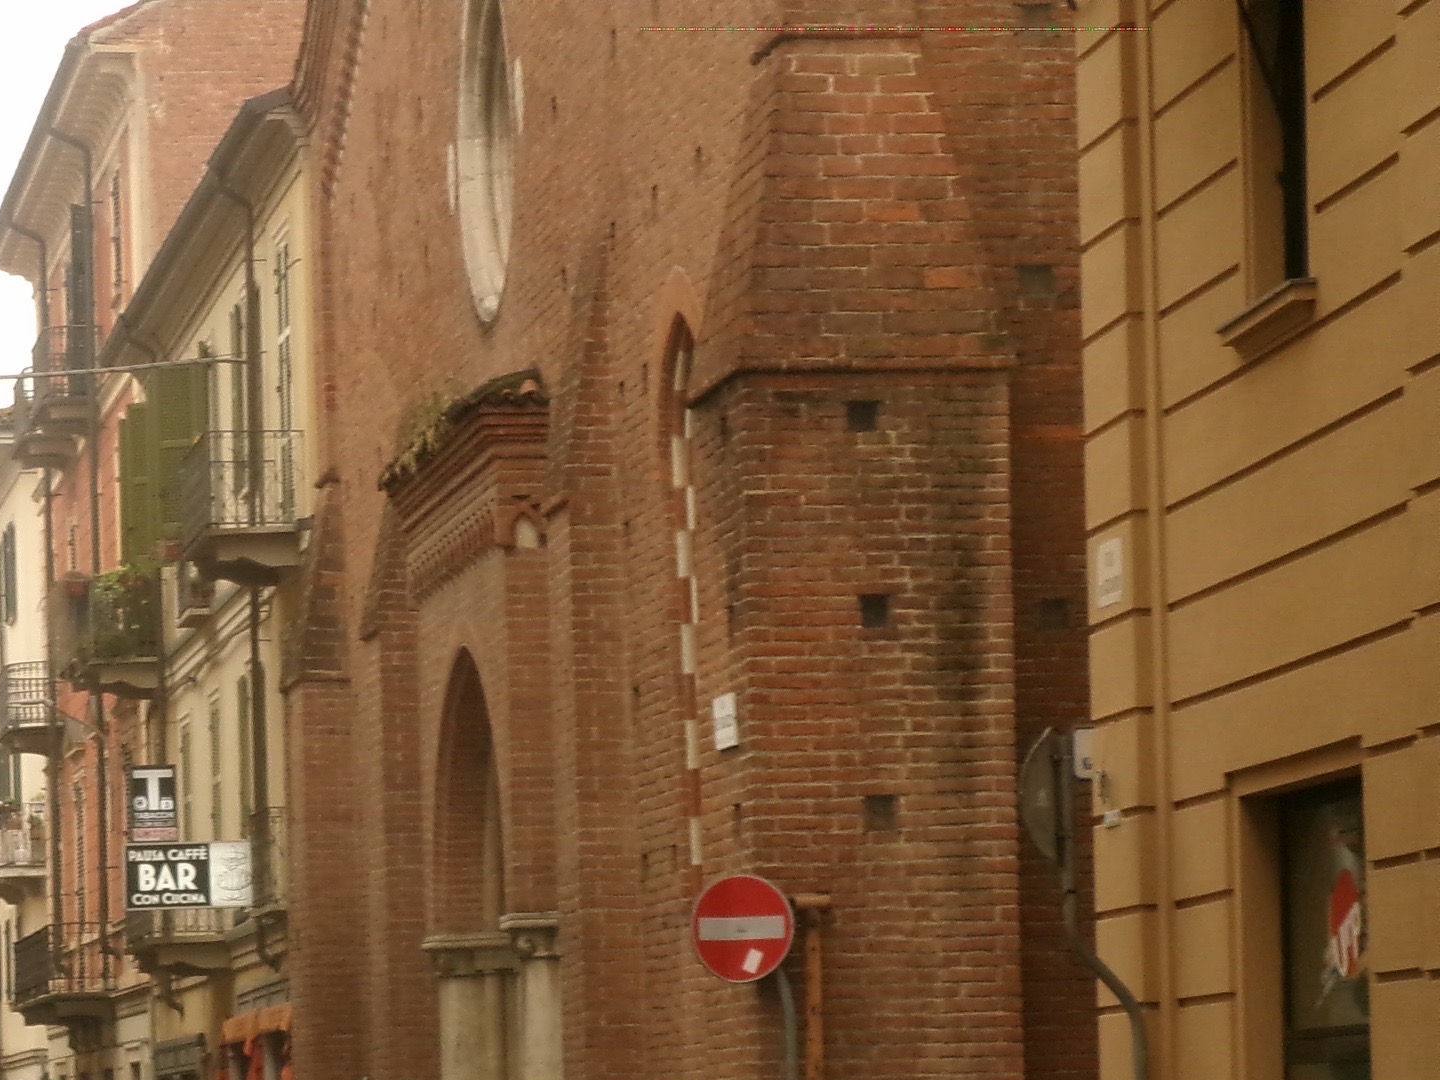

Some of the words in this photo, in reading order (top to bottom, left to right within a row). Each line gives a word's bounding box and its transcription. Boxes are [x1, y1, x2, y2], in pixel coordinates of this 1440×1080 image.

[132, 769, 173, 810] T
[128, 850, 165, 861] PAUSA
[138, 863, 198, 891] BAR
[132, 894, 160, 905] CON
[162, 893, 206, 904] CUCINA
